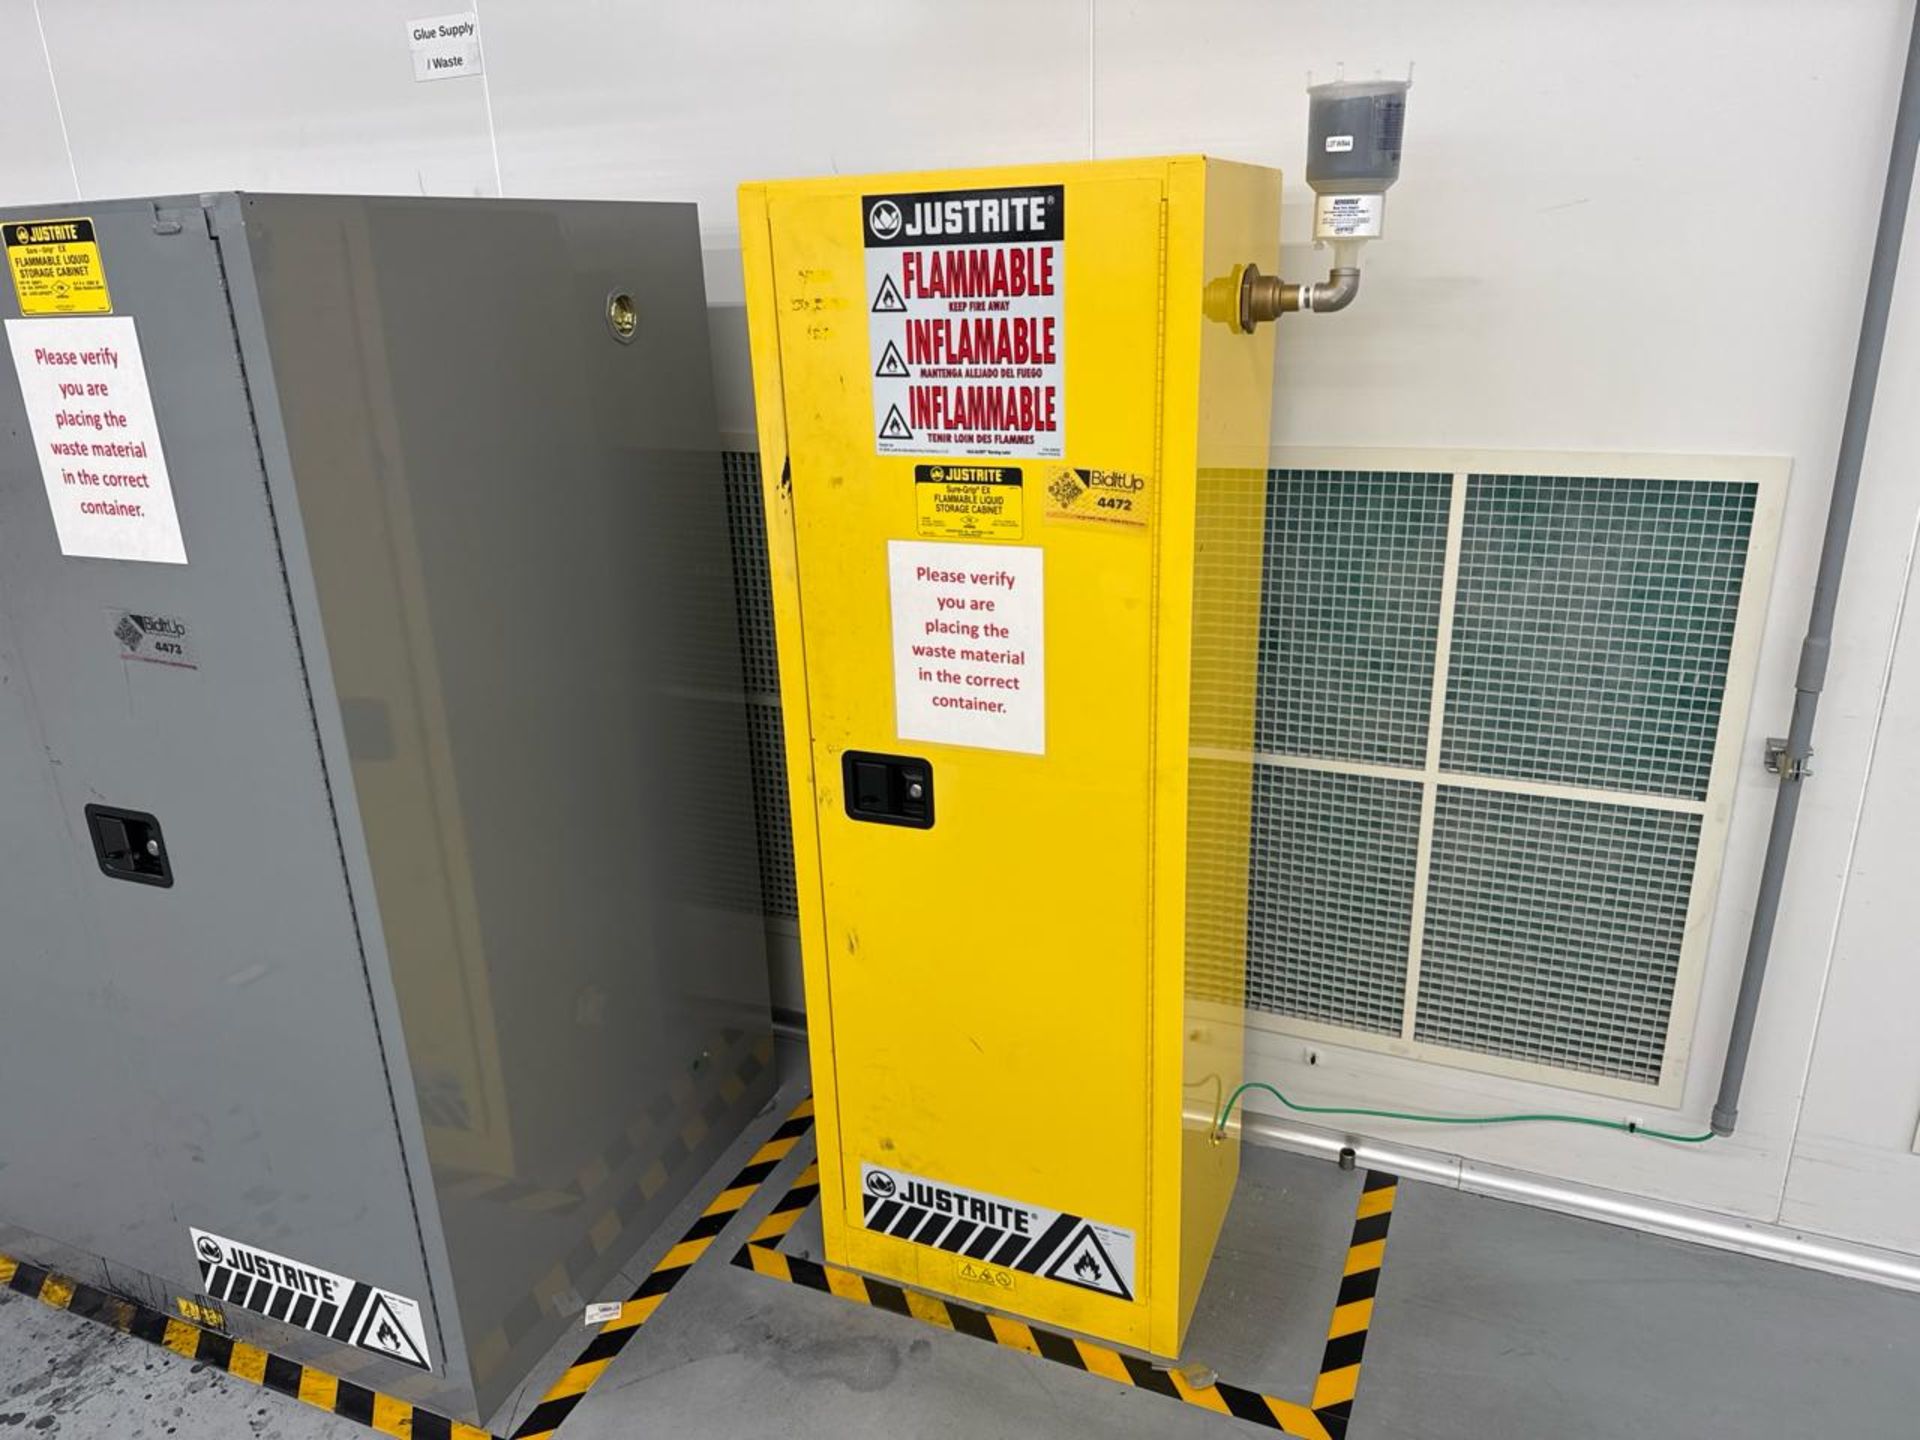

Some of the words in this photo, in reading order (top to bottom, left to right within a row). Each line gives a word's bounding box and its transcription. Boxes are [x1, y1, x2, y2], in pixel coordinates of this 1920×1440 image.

[413, 27, 437, 41] Glue
[438, 21, 474, 38] Supply
[432, 56, 464, 69] Waste
[31, 224, 78, 242] JUSTRITE
[15, 255, 62, 268] FLAMMABLE
[63, 254, 89, 266] LIQUID
[20, 267, 55, 279] STORAGE
[57, 266, 89, 277] CABINET
[902, 247, 1055, 300] FLAMMABLE
[948, 302, 966, 312] KEEP
[969, 301, 986, 312] FIRE
[988, 301, 1010, 312] AWAY
[906, 317, 1056, 366] INFLAMABLE
[34, 347, 78, 366] Please
[79, 347, 118, 369] verify
[920, 368, 963, 378] MANTENGA
[964, 368, 998, 378] ALEJADO
[1001, 368, 1015, 379] DEL
[1017, 368, 1043, 379] FUEGO
[58, 383, 83, 399] you
[87, 383, 109, 397] are
[909, 385, 1057, 432] INFLAMMABLE
[55, 409, 103, 431] placing
[104, 410, 127, 428] the
[927, 433, 952, 444] TENIR
[954, 433, 974, 444] LOIN
[976, 434, 992, 445] DES
[994, 434, 1035, 445] FLAMMES
[51, 441, 89, 456] waste
[92, 441, 148, 459] material
[61, 468, 75, 485] in
[78, 468, 100, 486] the
[103, 475, 150, 488] correct
[946, 467, 1003, 483] JUSTRITE
[81, 499, 145, 517] container.
[934, 493, 977, 505] FLAMMABLE
[980, 495, 1004, 506] LIQUID
[1097, 497, 1133, 511] 4472
[936, 503, 970, 514] STORAGE
[971, 505, 1002, 516] CABINET
[916, 566, 966, 584] Please
[970, 571, 1015, 590] verify
[937, 597, 965, 611] you
[970, 599, 995, 611] are
[925, 619, 979, 639] placing
[983, 623, 1009, 638] the
[912, 644, 956, 659] waste
[960, 650, 1025, 665] material
[918, 667, 932, 681] in
[936, 669, 961, 684] the
[966, 674, 1020, 690] correct
[932, 695, 1007, 714] container.
